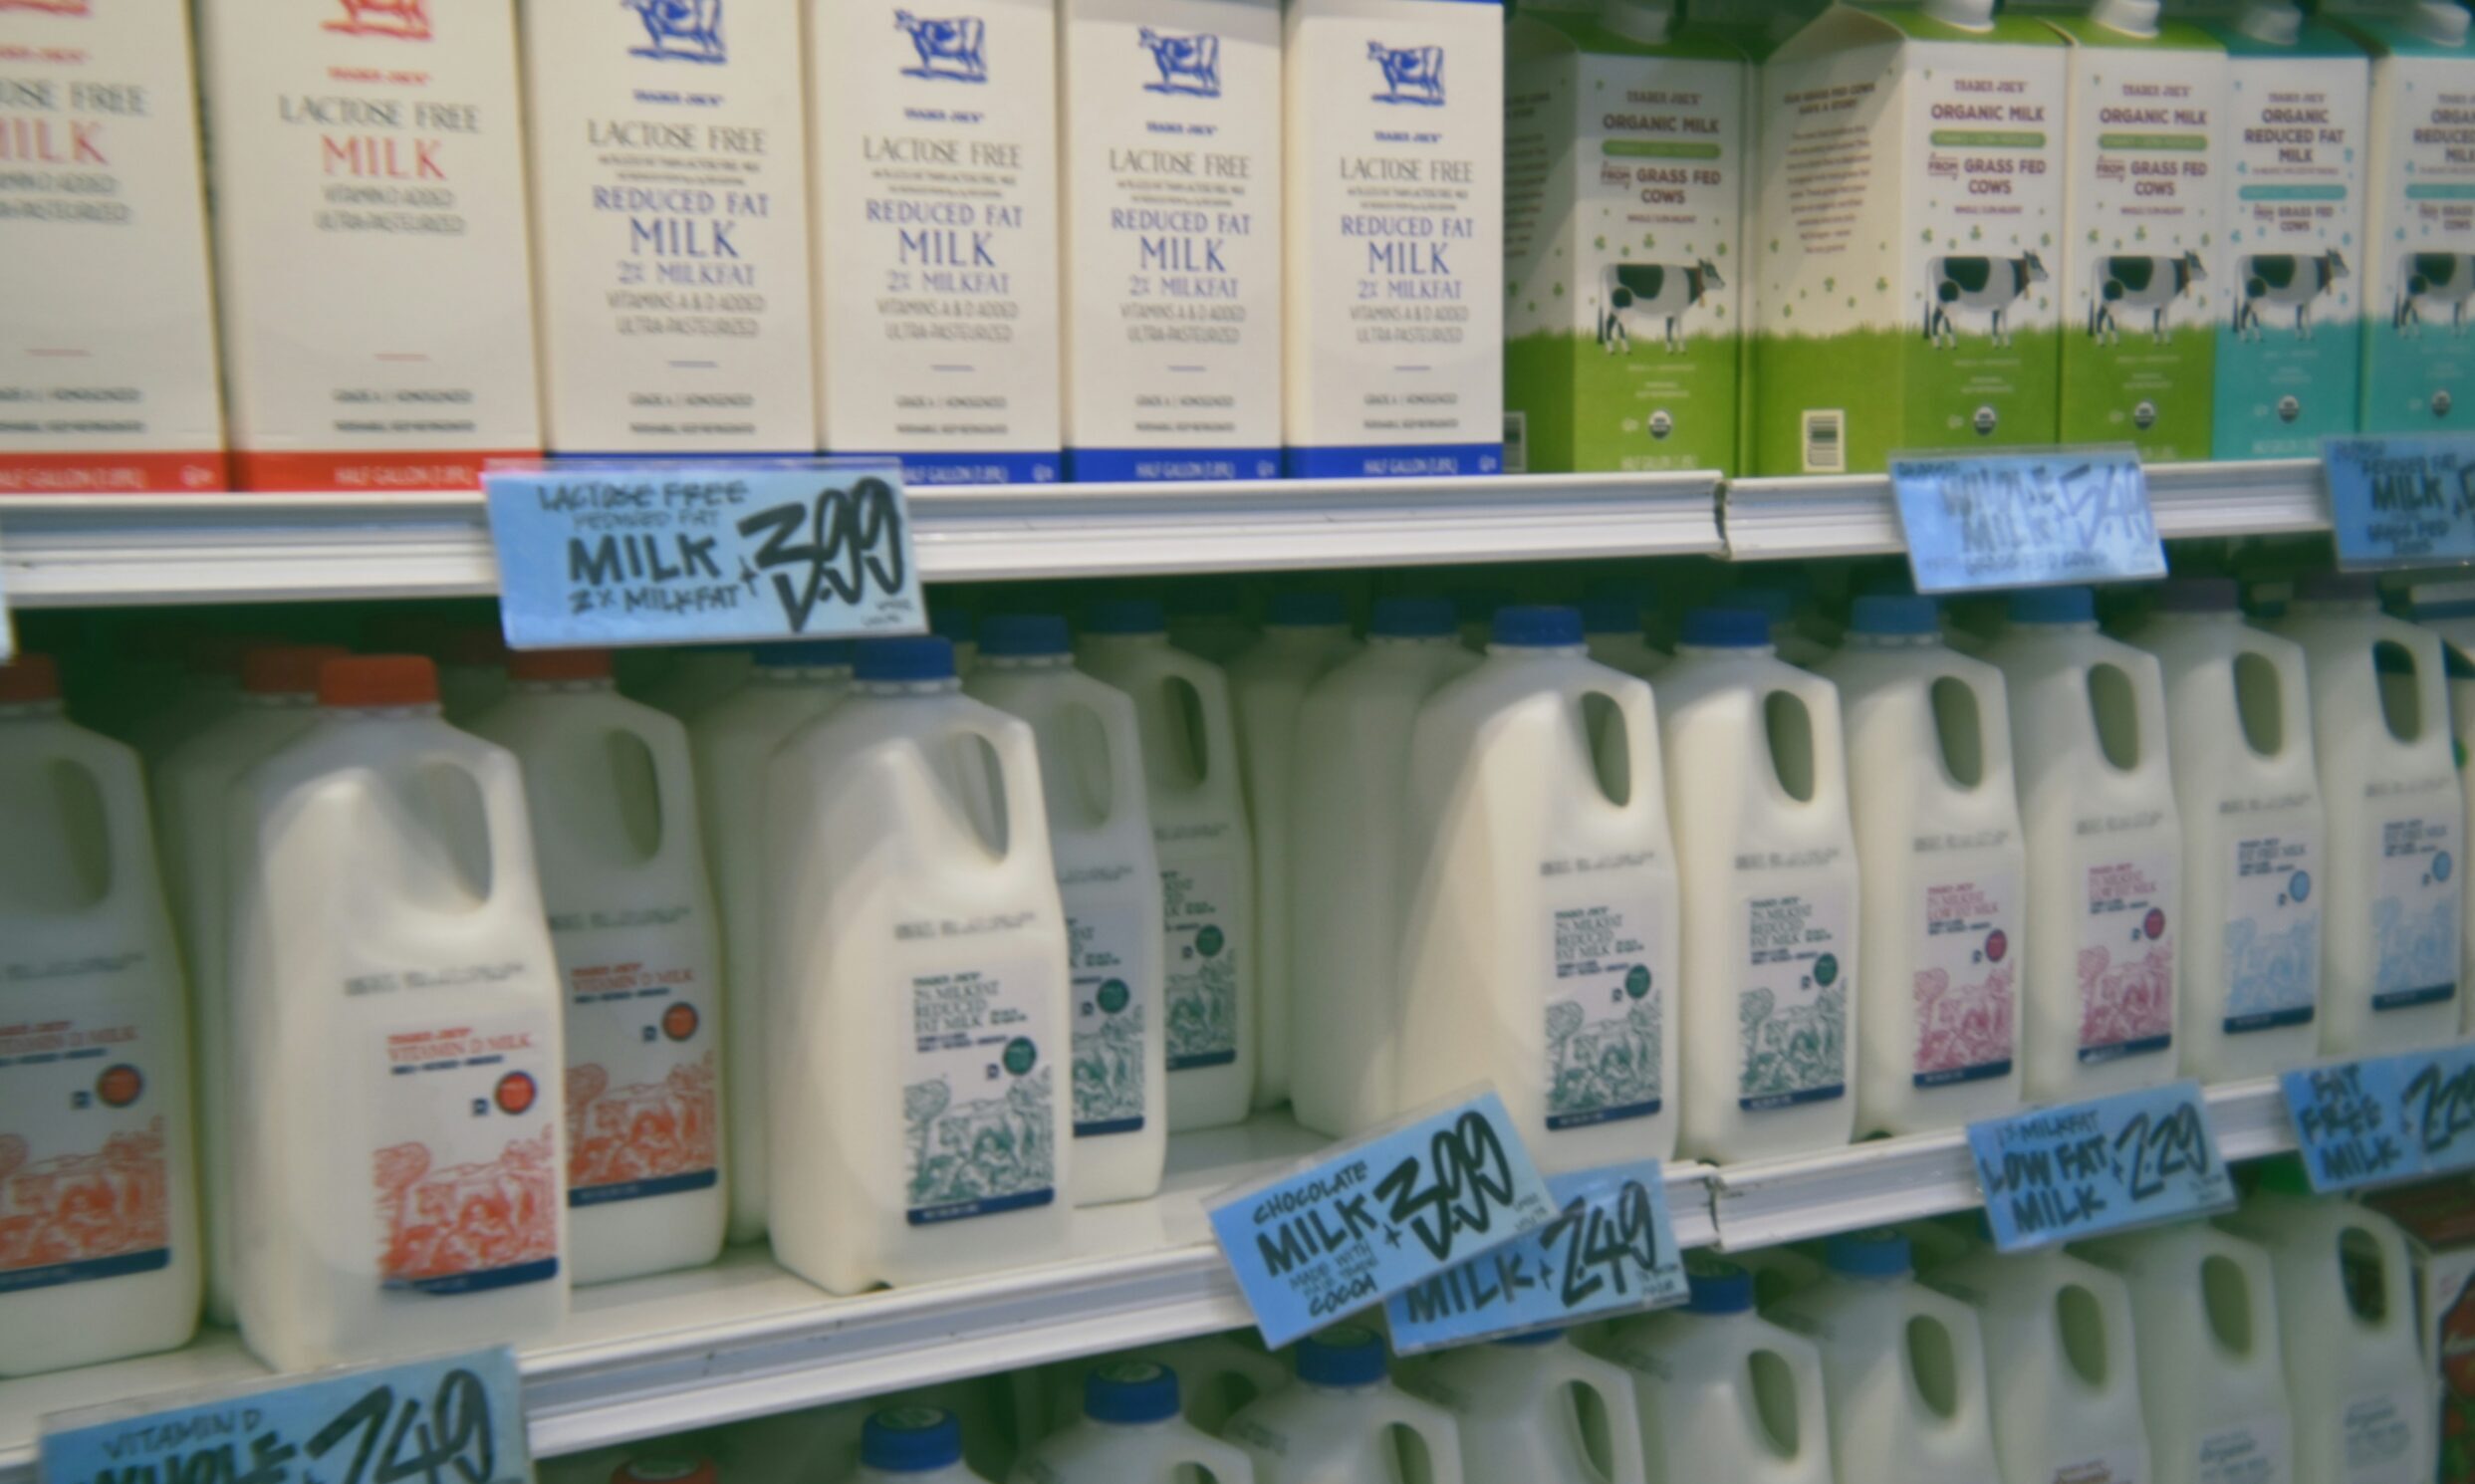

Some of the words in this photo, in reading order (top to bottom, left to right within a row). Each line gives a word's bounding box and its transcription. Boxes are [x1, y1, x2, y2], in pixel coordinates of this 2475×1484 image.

[279, 95, 401, 129] LACTOSE
[414, 102, 480, 133] FREE
[1603, 114, 1677, 132] ORGANIC
[1682, 117, 1720, 134] MILK
[1930, 104, 2003, 121] ORGANIC
[2009, 105, 2046, 122] MILK
[2099, 108, 2168, 124] ORGANIC
[2173, 109, 2207, 125] MILK
[2261, 109, 2329, 124] ORGANIC
[0, 119, 108, 165] ILK
[588, 119, 696, 149] LACTOSE
[707, 124, 767, 156] FREE
[864, 134, 960, 164] LACTOSE
[970, 140, 1021, 169] FREE
[2244, 128, 2315, 143] REDUCED
[2319, 129, 2345, 144] FAT
[321, 134, 446, 179] MILK
[1111, 149, 1195, 175] LACTOSE
[1204, 154, 1251, 179] FREE
[1341, 157, 1421, 181] LACTOSE
[1430, 160, 1473, 183] FREE
[1964, 158, 2014, 174] GRASS
[2019, 158, 2047, 174] FED
[2130, 160, 2177, 176] GRASS
[2182, 160, 2207, 177] FED
[2278, 147, 2313, 163] MILK
[1636, 168, 1687, 184] GRASS
[1693, 168, 1722, 186] FED
[1968, 179, 2012, 195] COWS
[2134, 181, 2175, 197] COWS
[594, 185, 714, 215] REDUCED
[726, 192, 768, 217] FAT
[1640, 188, 1685, 204] COWS
[866, 199, 975, 226] REDUCED
[986, 204, 1024, 229] FAT
[1112, 208, 1208, 234] REDUCED
[1217, 213, 1251, 235] FAT
[1342, 215, 1432, 237] REDUCED
[1442, 217, 1474, 238] FAT
[628, 215, 740, 259] MILK
[899, 227, 995, 267] MILK
[1140, 236, 1226, 272] MILK
[1368, 242, 1450, 275] MILK
[655, 263, 755, 288] MILKFAT
[922, 271, 1010, 296] MILKFAT
[1160, 277, 1238, 299] MILKFAT
[1388, 280, 1461, 300] MILKFAT
[538, 484, 653, 512] LACTOSE
[662, 480, 749, 508] FREE
[2370, 474, 2445, 511] MILK
[678, 507, 720, 528] FAT
[567, 533, 722, 586] MILK
[736, 475, 905, 632] 3.99
[623, 584, 739, 613] MILKFAT
[488, 1032, 533, 1052] MILK
[1979, 1149, 2053, 1195] LOW
[2054, 1135, 2108, 1182] FAT
[2113, 1102, 2208, 1202] 2.29
[2320, 1135, 2402, 1180] MILK
[1252, 1159, 1367, 1226] CHOCOLATE
[1372, 1109, 1515, 1262] 3.99
[2011, 1185, 2108, 1234] MILK
[1256, 1193, 1378, 1278] MILK
[1539, 1179, 1656, 1308] 2.49
[1308, 1272, 1378, 1318] COCOA
[1405, 1251, 1535, 1324] MILK
[103, 1412, 234, 1461] VITAMIN
[242, 1407, 262, 1432] D
[74, 1428, 297, 1484] HOLE
